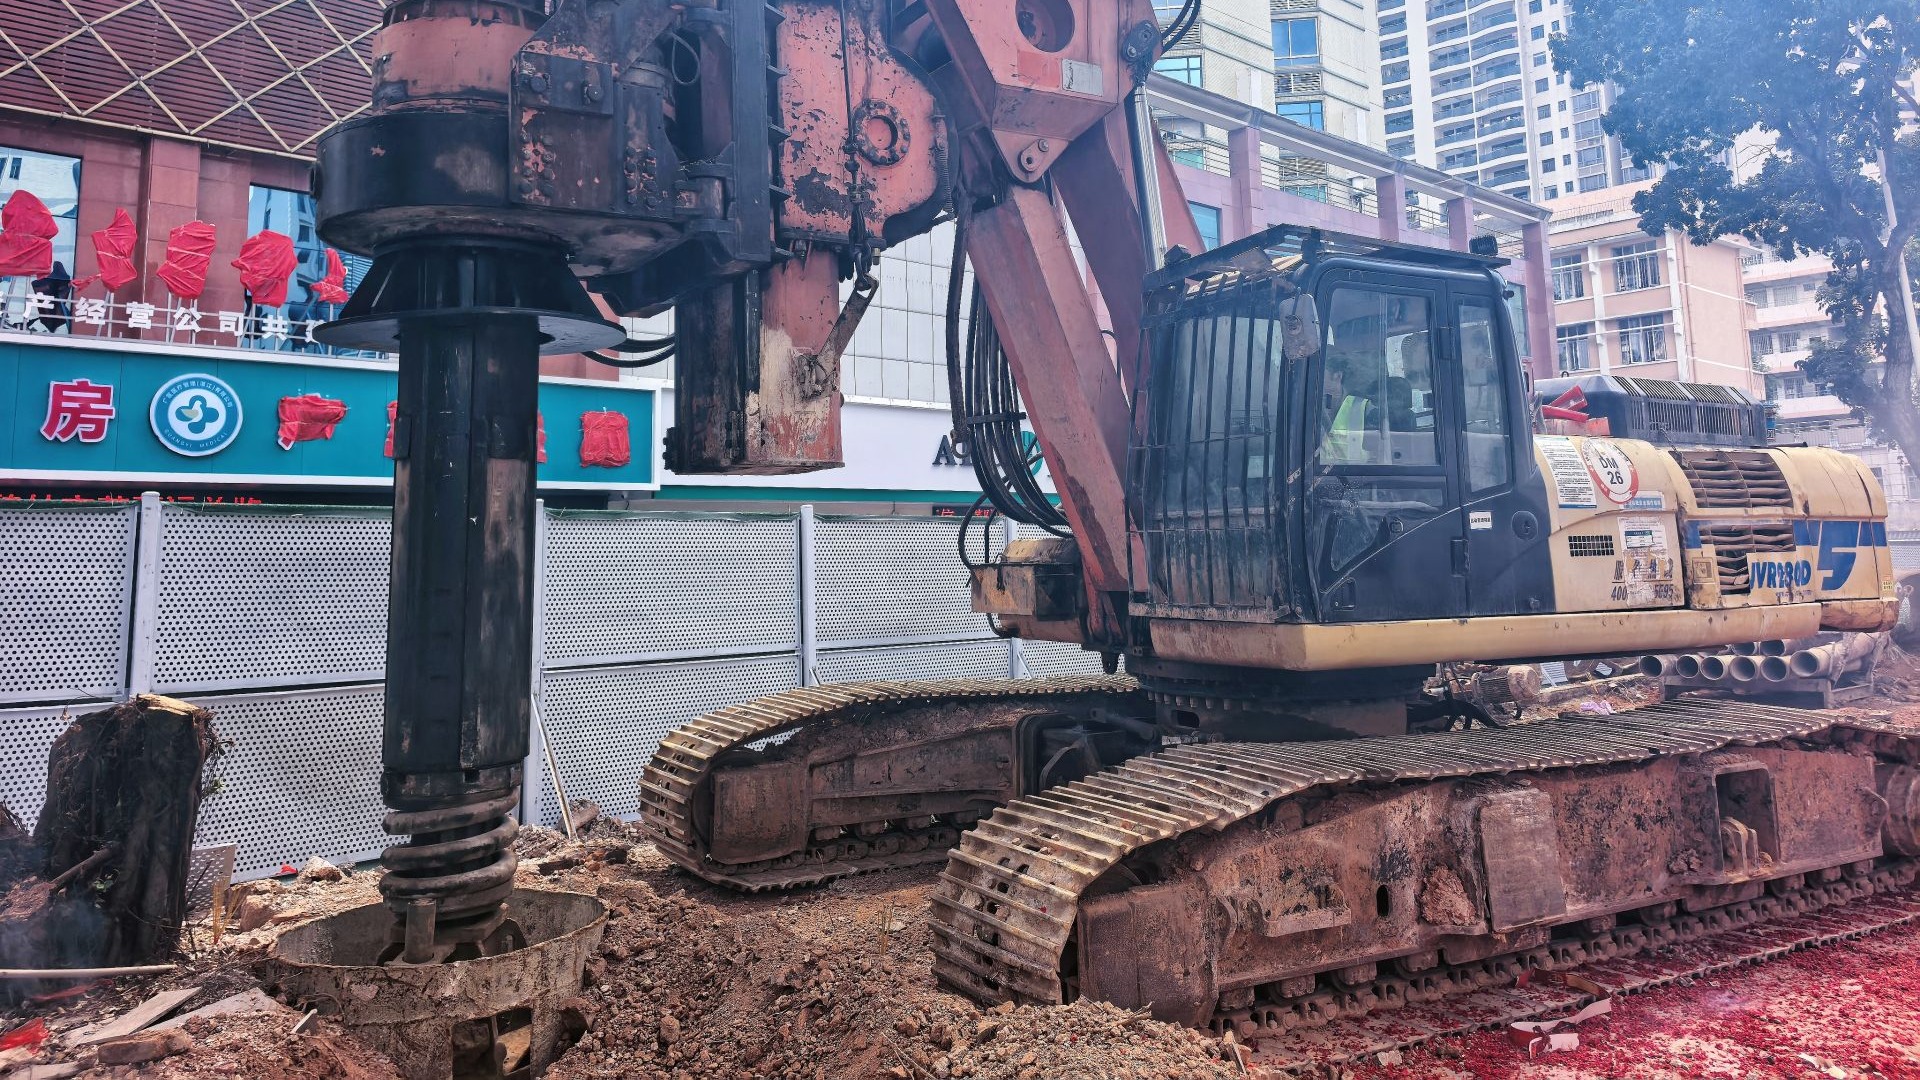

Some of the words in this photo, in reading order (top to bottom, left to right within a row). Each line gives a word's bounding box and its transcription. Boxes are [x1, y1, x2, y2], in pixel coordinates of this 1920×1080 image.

[40, 378, 115, 444] 房
[199, 432, 228, 448] MEDICAL
[1598, 455, 1619, 470] DM
[1607, 470, 1624, 486] 26
